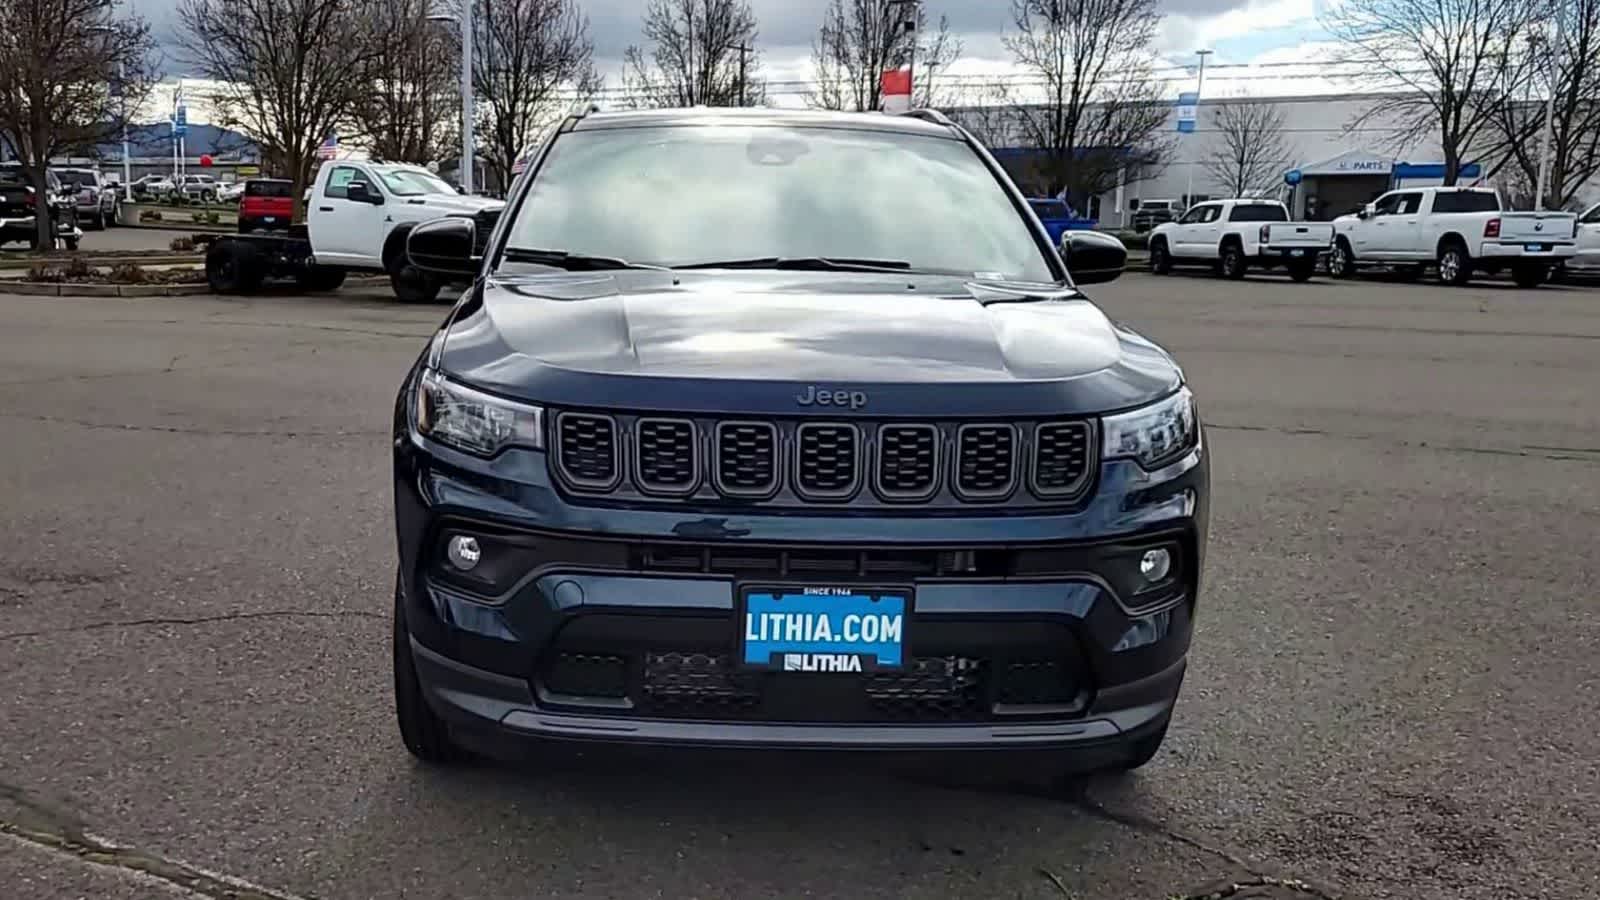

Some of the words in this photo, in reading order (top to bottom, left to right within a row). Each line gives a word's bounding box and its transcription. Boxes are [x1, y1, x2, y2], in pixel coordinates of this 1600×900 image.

[1353, 161, 1384, 170] PARTS
[796, 385, 867, 409] Jeep
[803, 587, 830, 596] SINCE
[745, 612, 903, 643] LITHIA.COM
[802, 654, 862, 672] LITHIA
